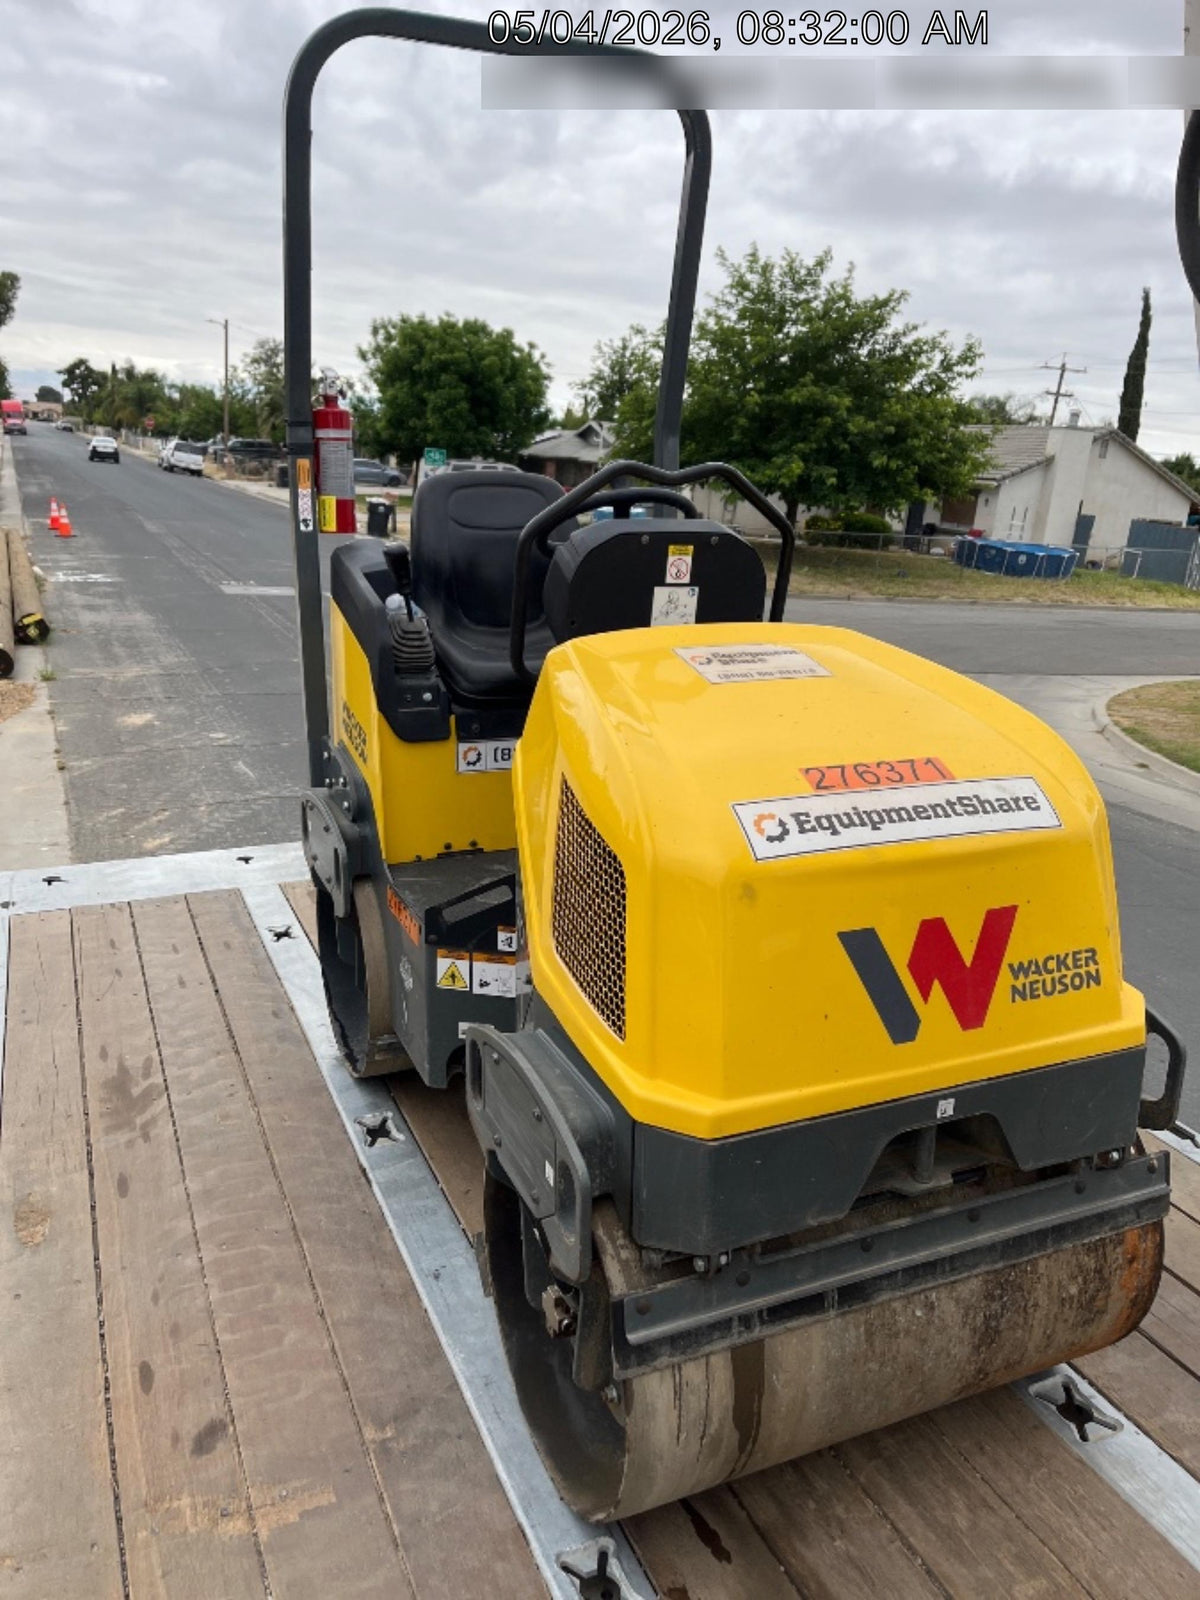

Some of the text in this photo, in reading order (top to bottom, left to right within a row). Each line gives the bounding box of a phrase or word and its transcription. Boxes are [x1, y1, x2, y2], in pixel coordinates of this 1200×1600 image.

[804, 757, 948, 791] 276371
[790, 794, 1041, 837] EquipmentShare
[1007, 947, 1099, 982] WACKER
[1010, 968, 1102, 1004] NEUSON
